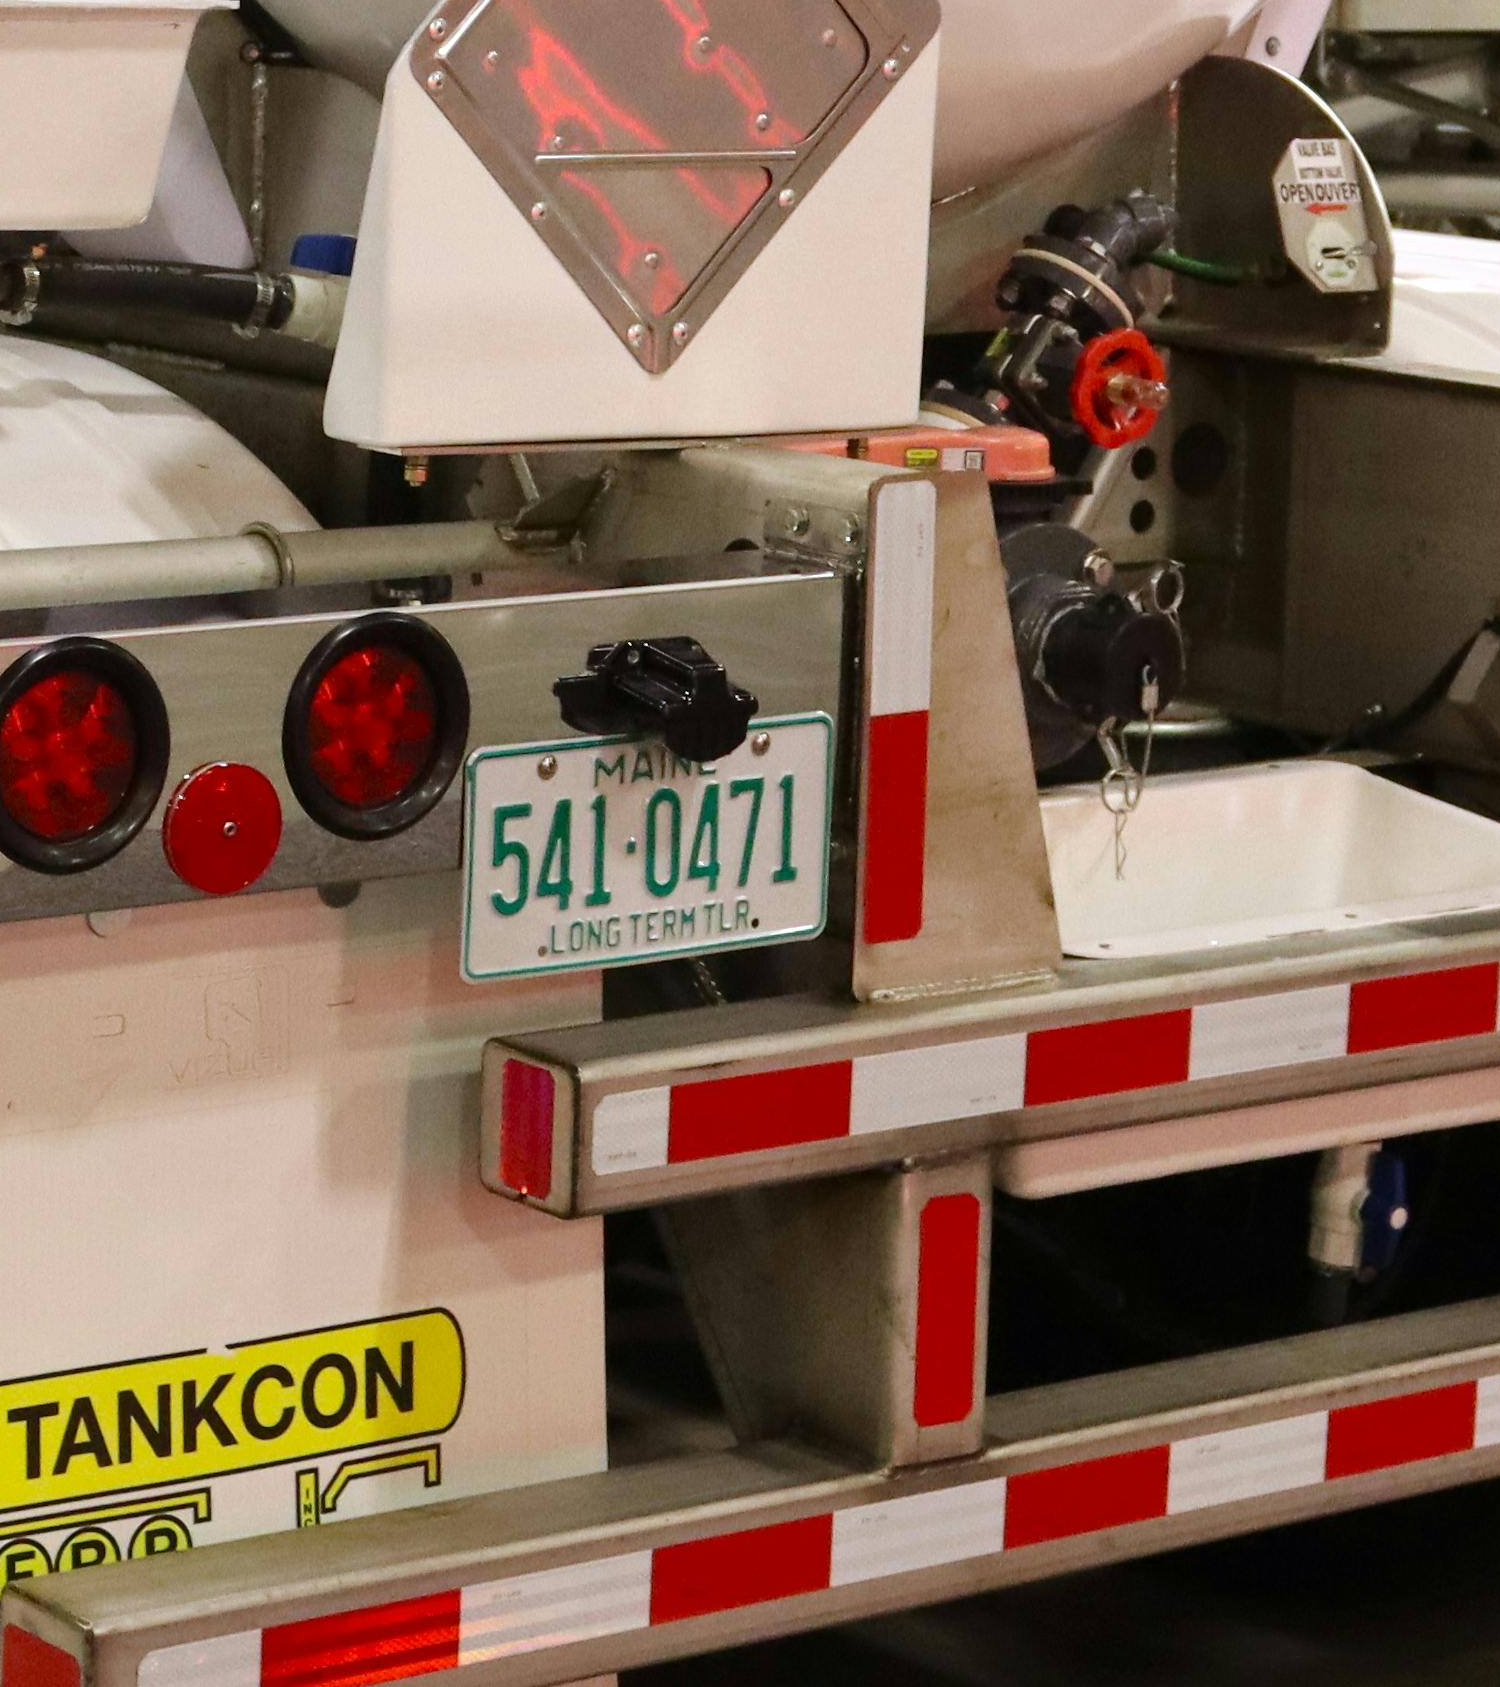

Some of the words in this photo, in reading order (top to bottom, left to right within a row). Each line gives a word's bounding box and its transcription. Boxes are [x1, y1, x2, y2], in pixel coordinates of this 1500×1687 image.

[552, 916, 621, 954] LONG
[629, 906, 696, 944] TERM
[7, 1342, 414, 1479] TANKCON
